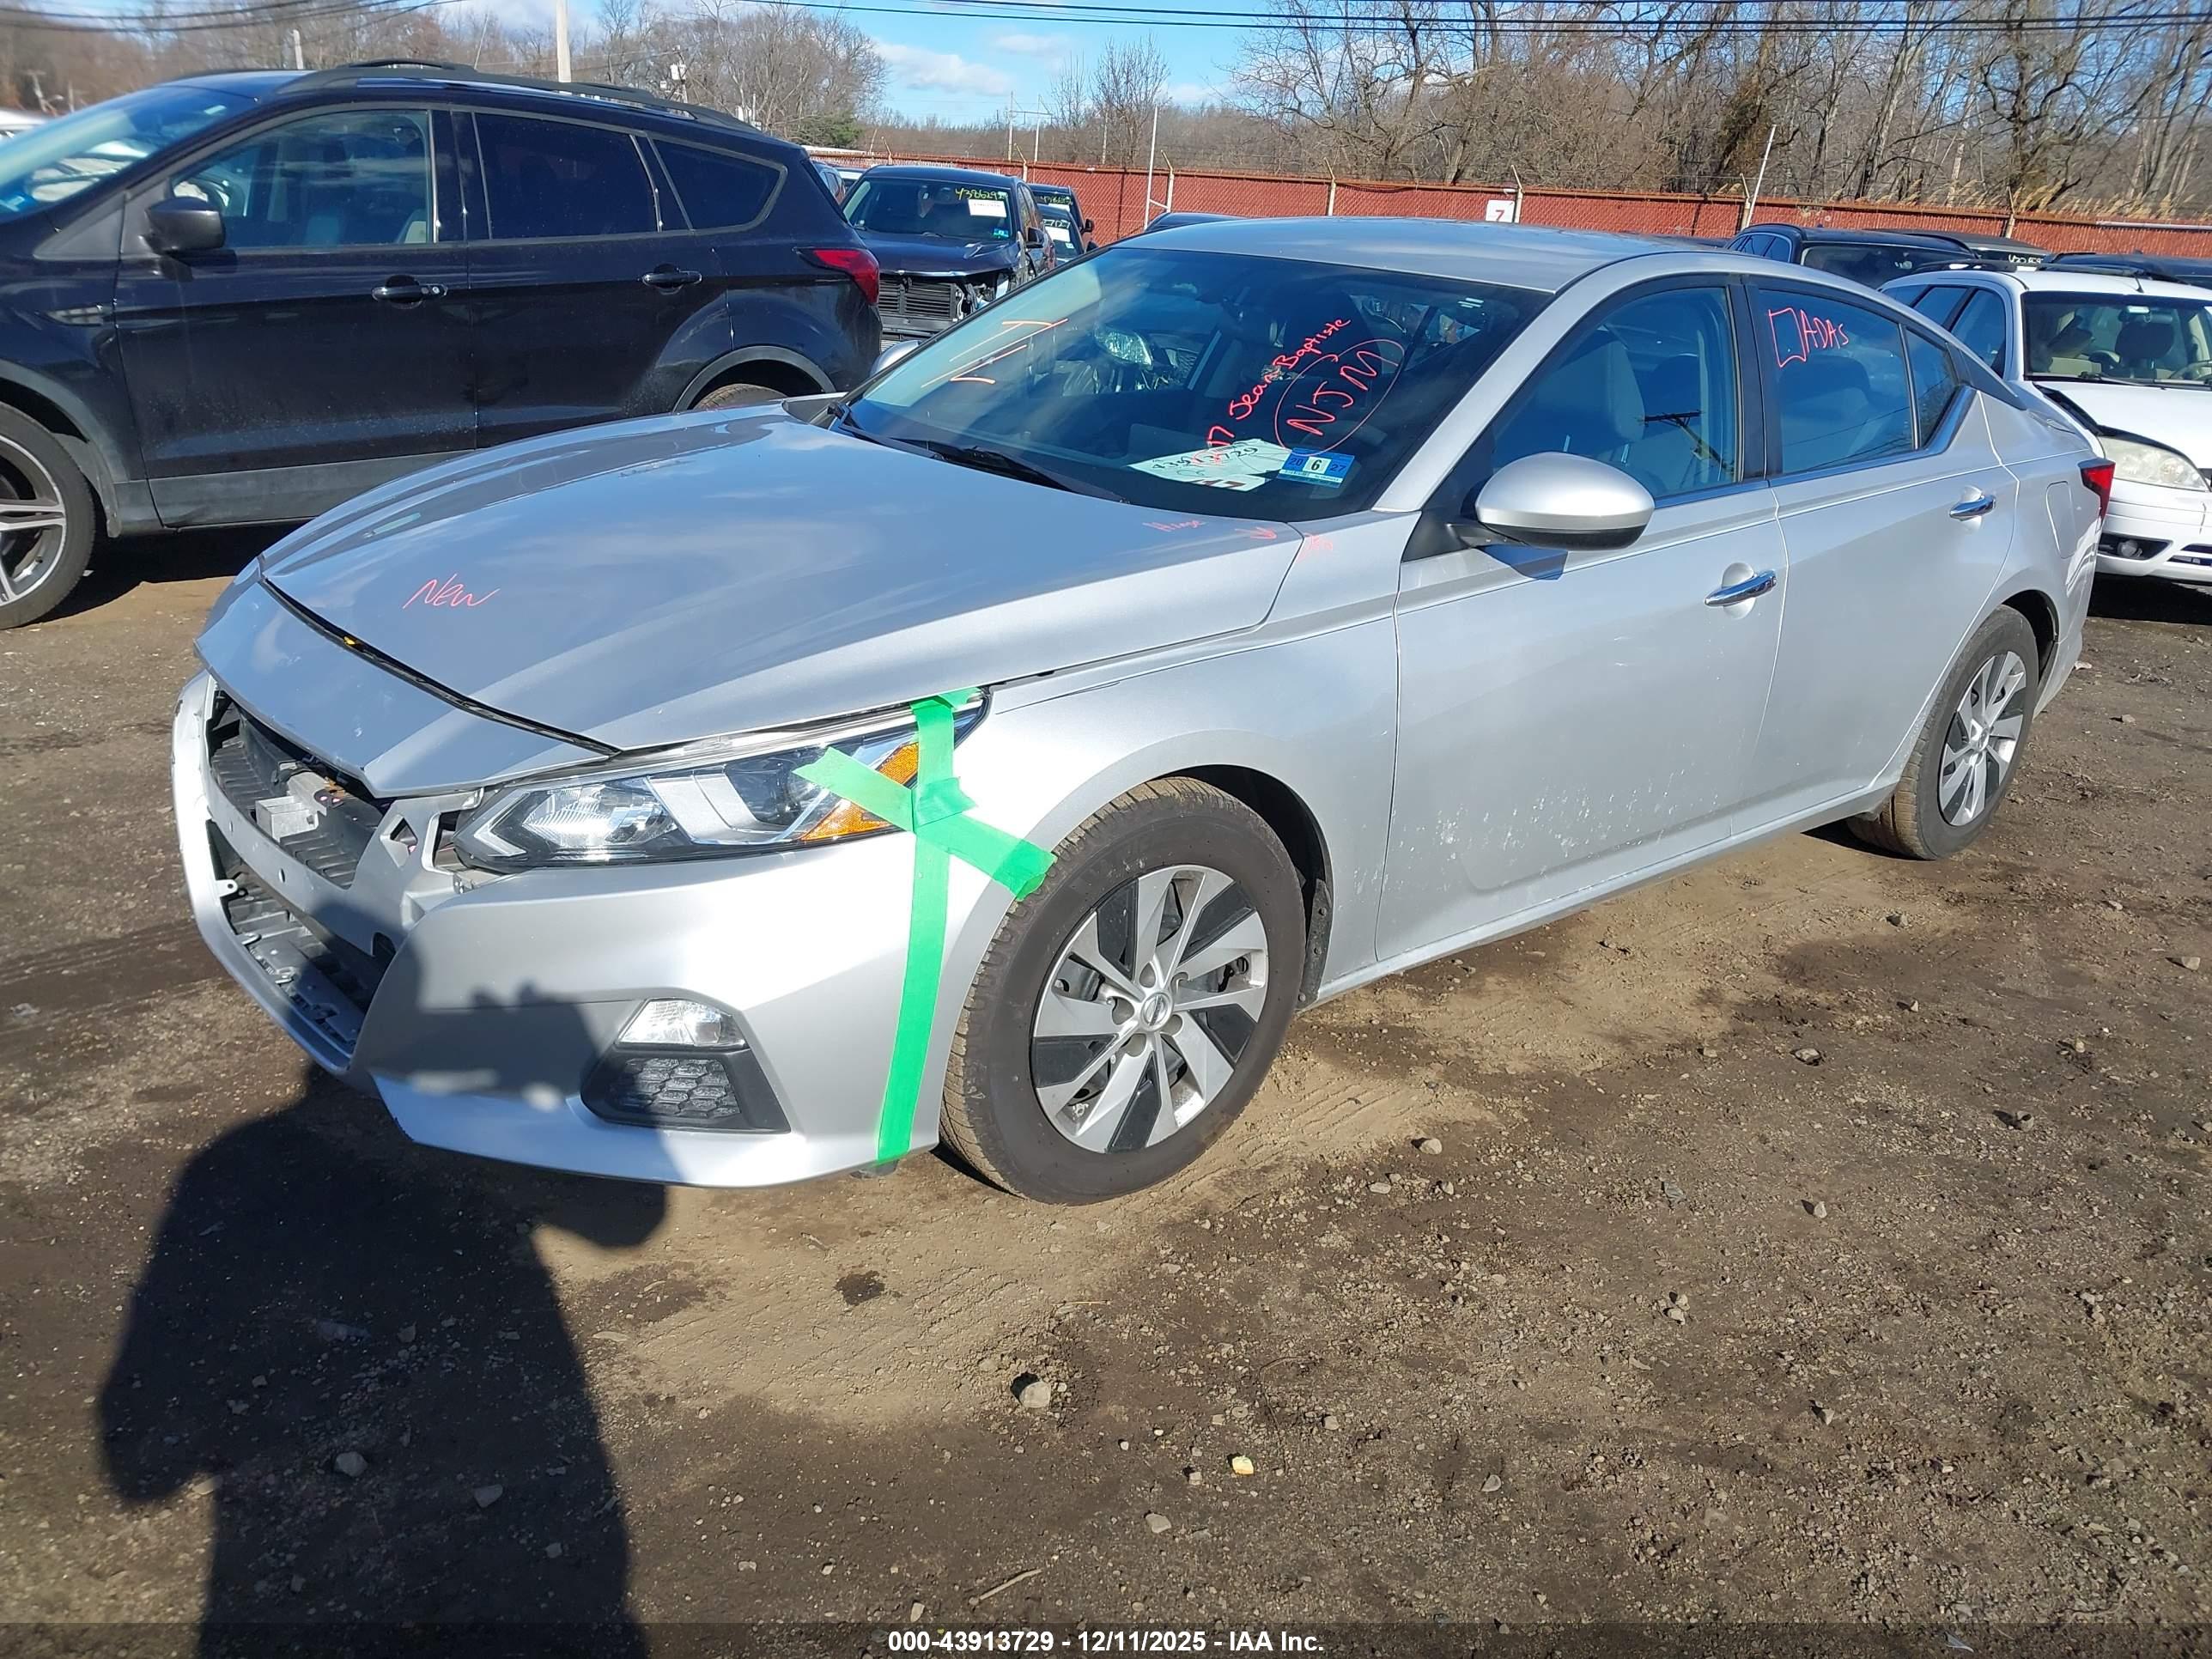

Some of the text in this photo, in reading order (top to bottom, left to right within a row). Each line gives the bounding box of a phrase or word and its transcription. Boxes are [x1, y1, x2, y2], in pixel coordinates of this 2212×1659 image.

[1495, 209, 1505, 222] 7
[1286, 349, 1400, 436] NJM
[1288, 457, 1347, 472] 20 6 27
[402, 573, 501, 610] New
